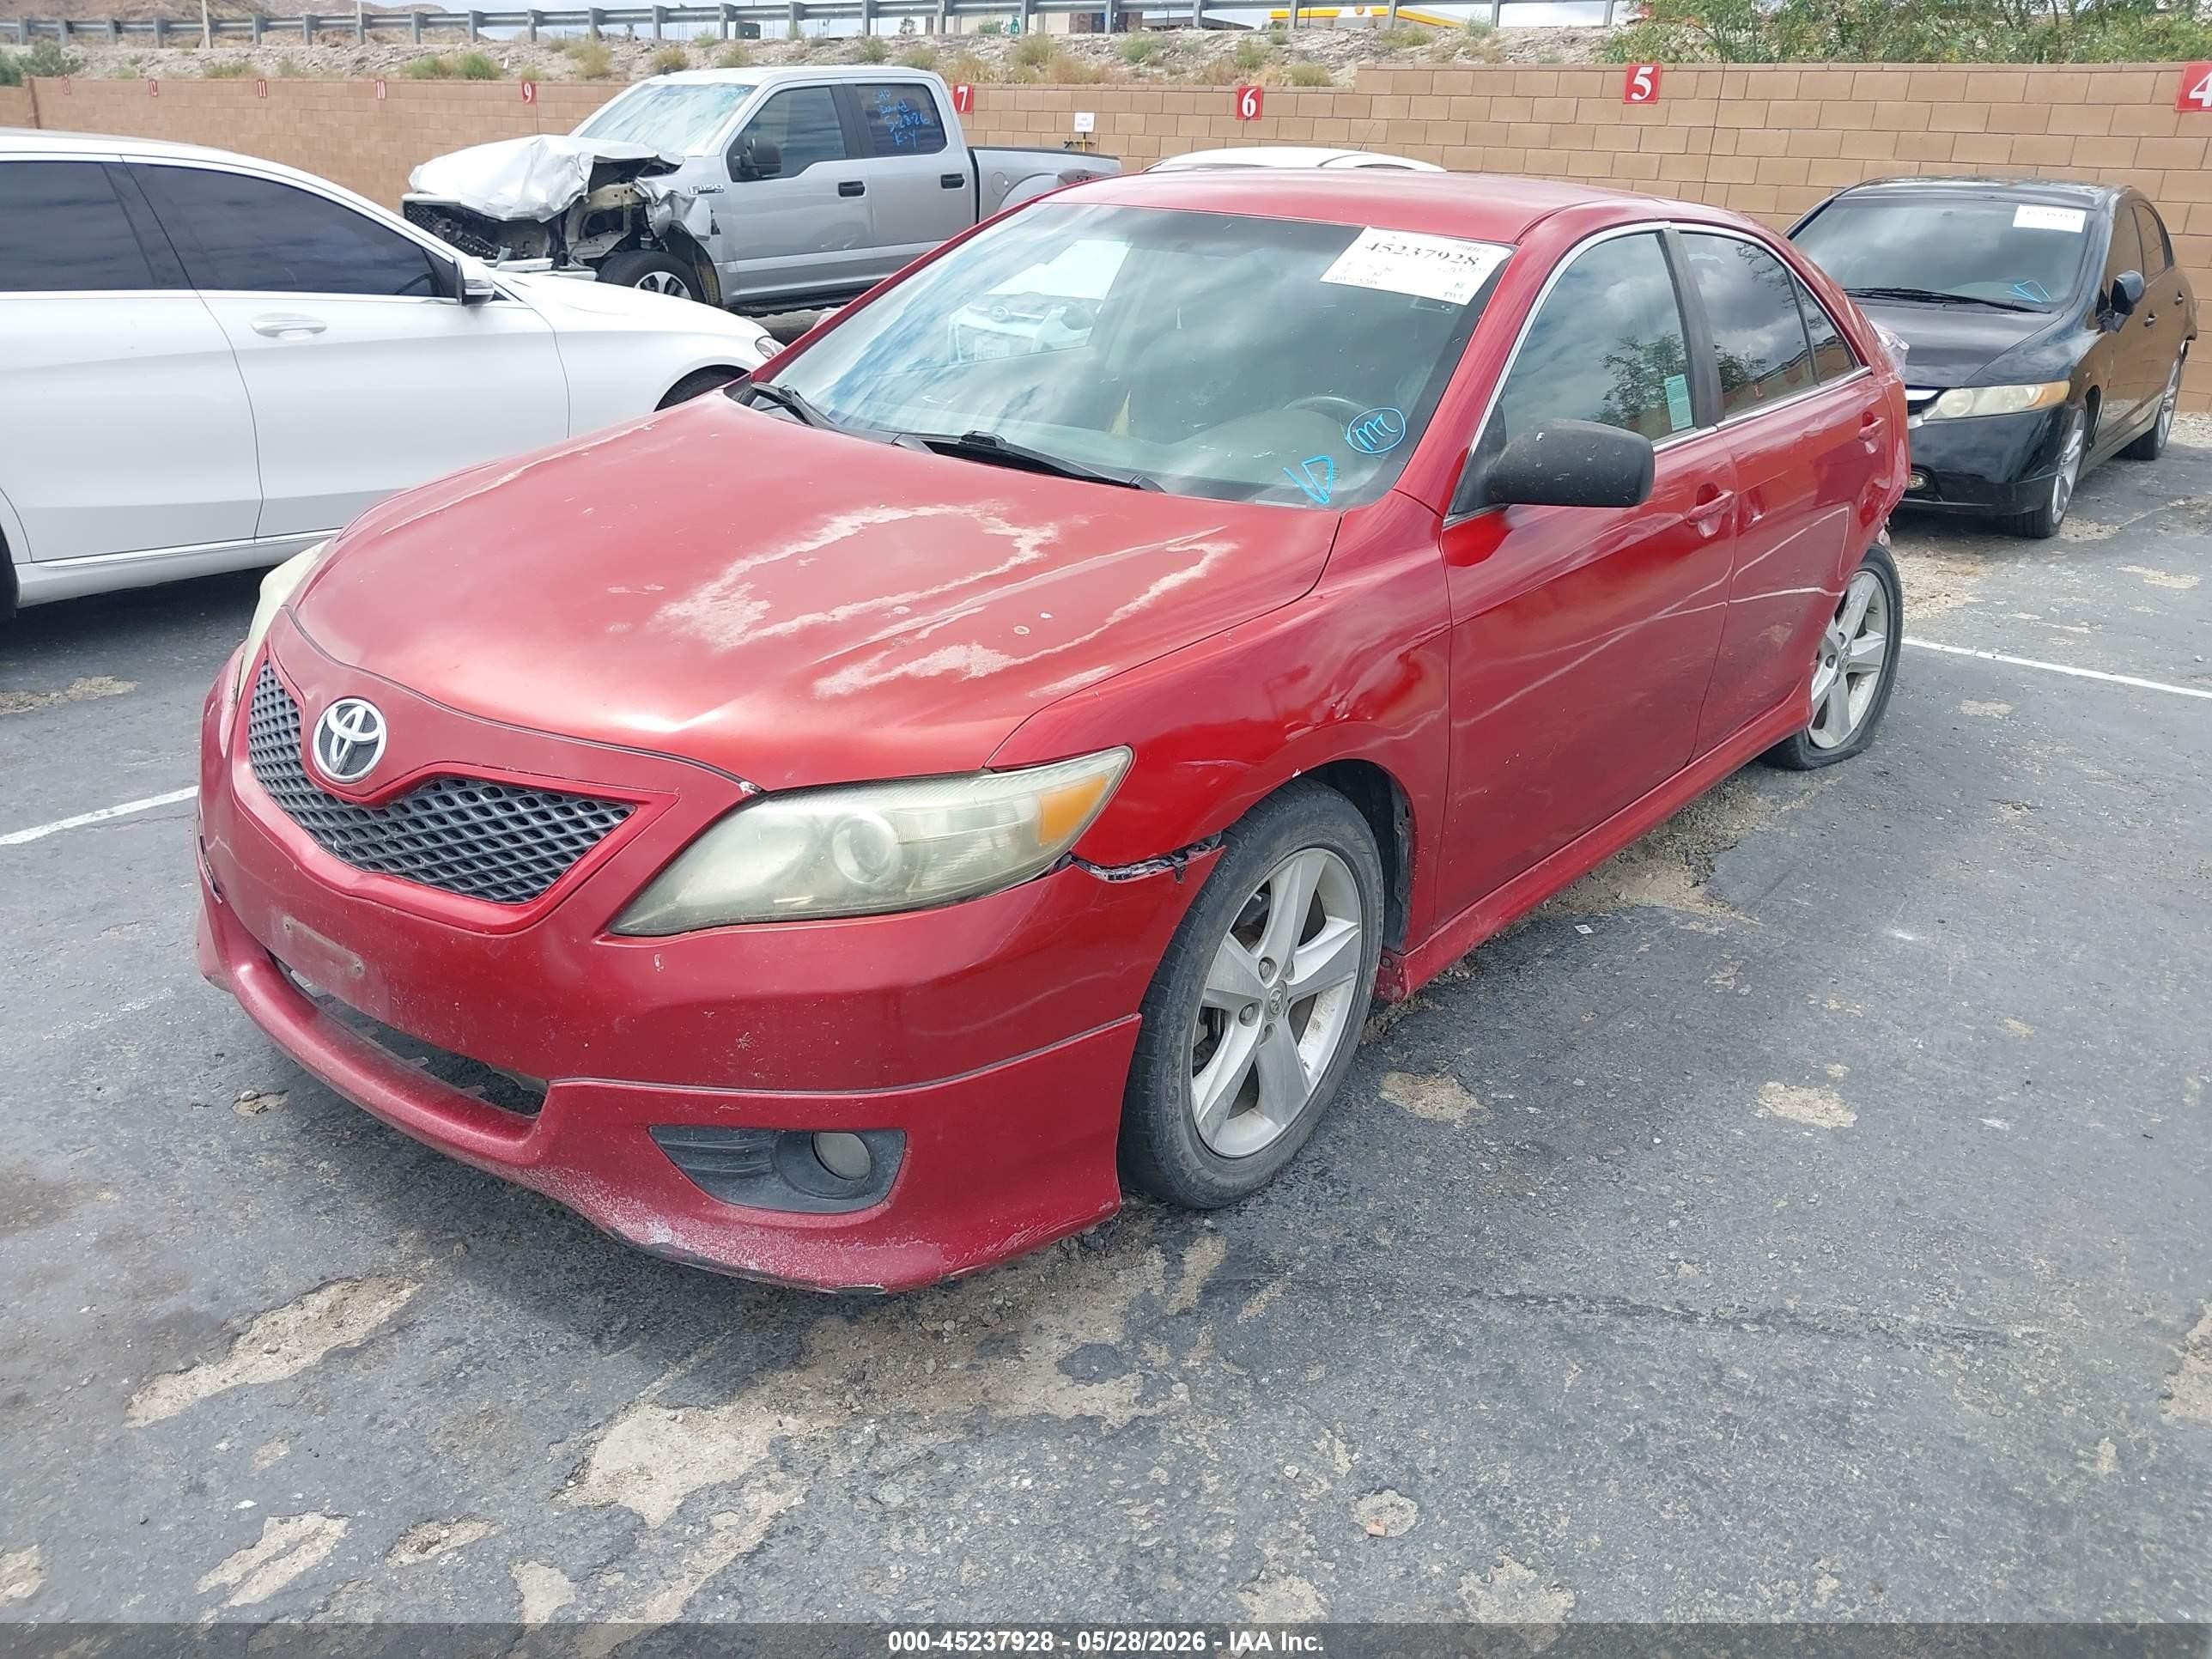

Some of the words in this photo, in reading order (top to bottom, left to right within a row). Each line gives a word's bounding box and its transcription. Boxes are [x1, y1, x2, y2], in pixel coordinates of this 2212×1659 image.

[524, 82, 532, 103] 9
[1631, 66, 1654, 100] 5
[2189, 70, 2212, 107] 4
[957, 86, 969, 112] 7
[1242, 88, 1257, 117] 6
